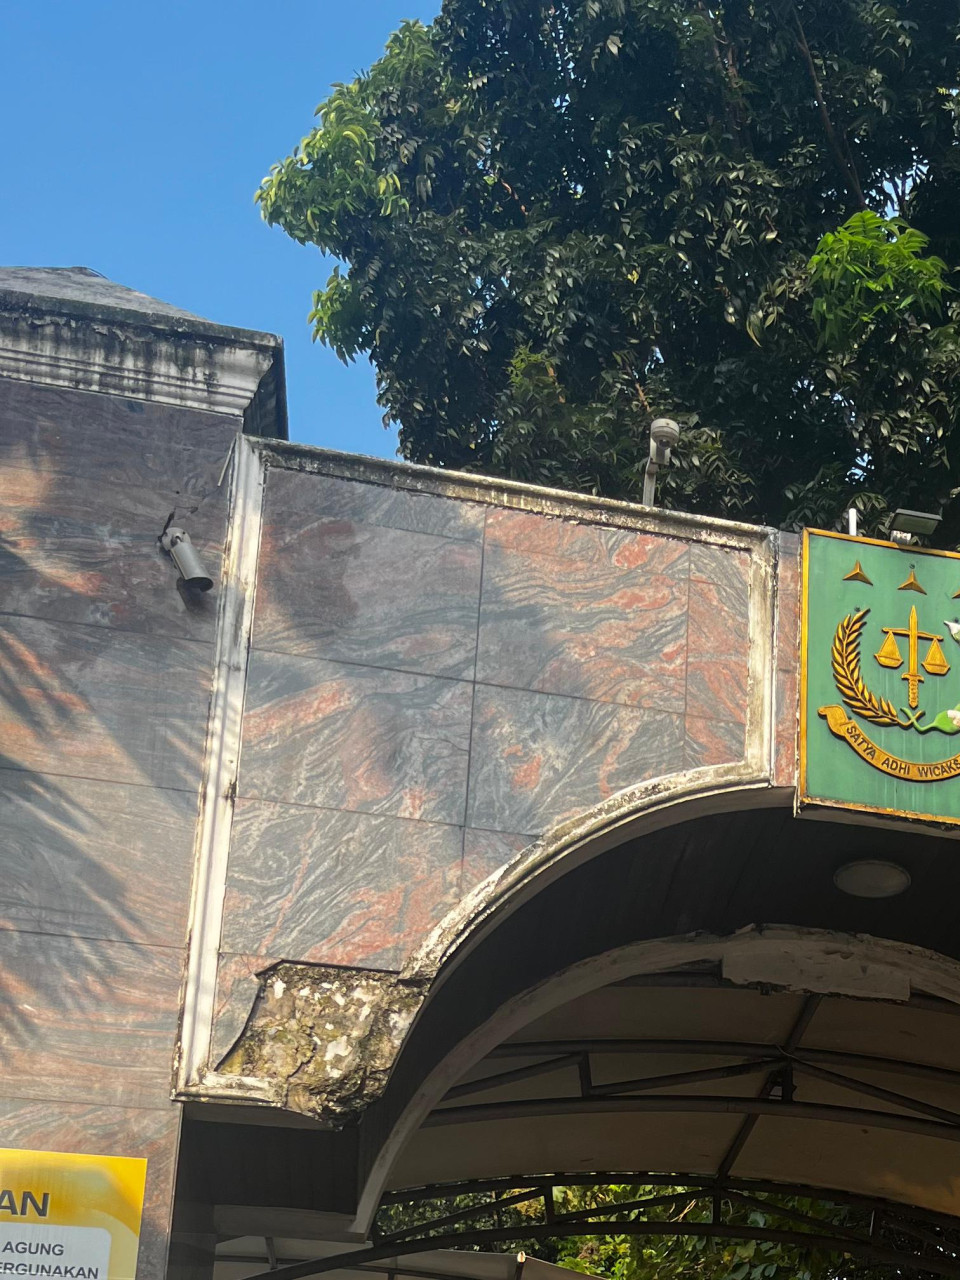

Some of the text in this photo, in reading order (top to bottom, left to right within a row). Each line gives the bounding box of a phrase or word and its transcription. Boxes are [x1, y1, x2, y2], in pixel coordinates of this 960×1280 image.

[847, 725, 876, 760] SATYA
[881, 757, 910, 776] ADHI
[0, 1190, 50, 1217] AN
[2, 1241, 64, 1256] AGUNG
